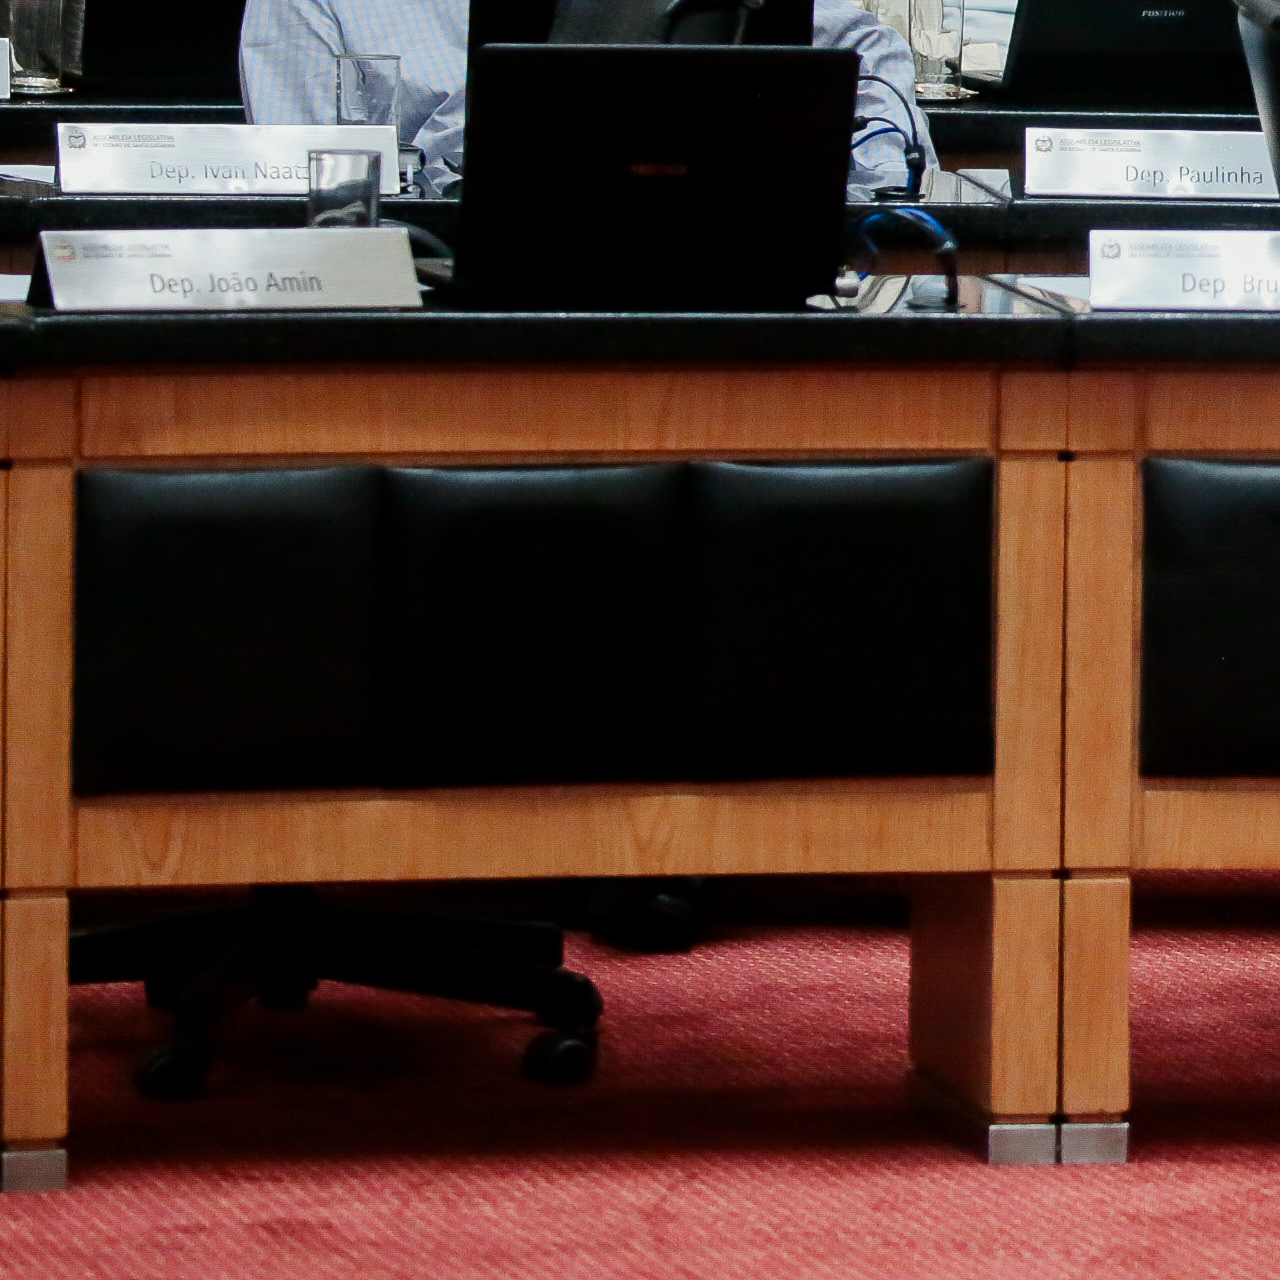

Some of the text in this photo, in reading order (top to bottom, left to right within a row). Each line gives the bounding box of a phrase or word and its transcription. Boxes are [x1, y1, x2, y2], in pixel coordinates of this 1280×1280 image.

[149, 160, 195, 184] Dep.
[204, 160, 246, 179] Ivan
[1125, 165, 1264, 188] Dep. Paulinha
[150, 271, 323, 298] Dep. João Amin
